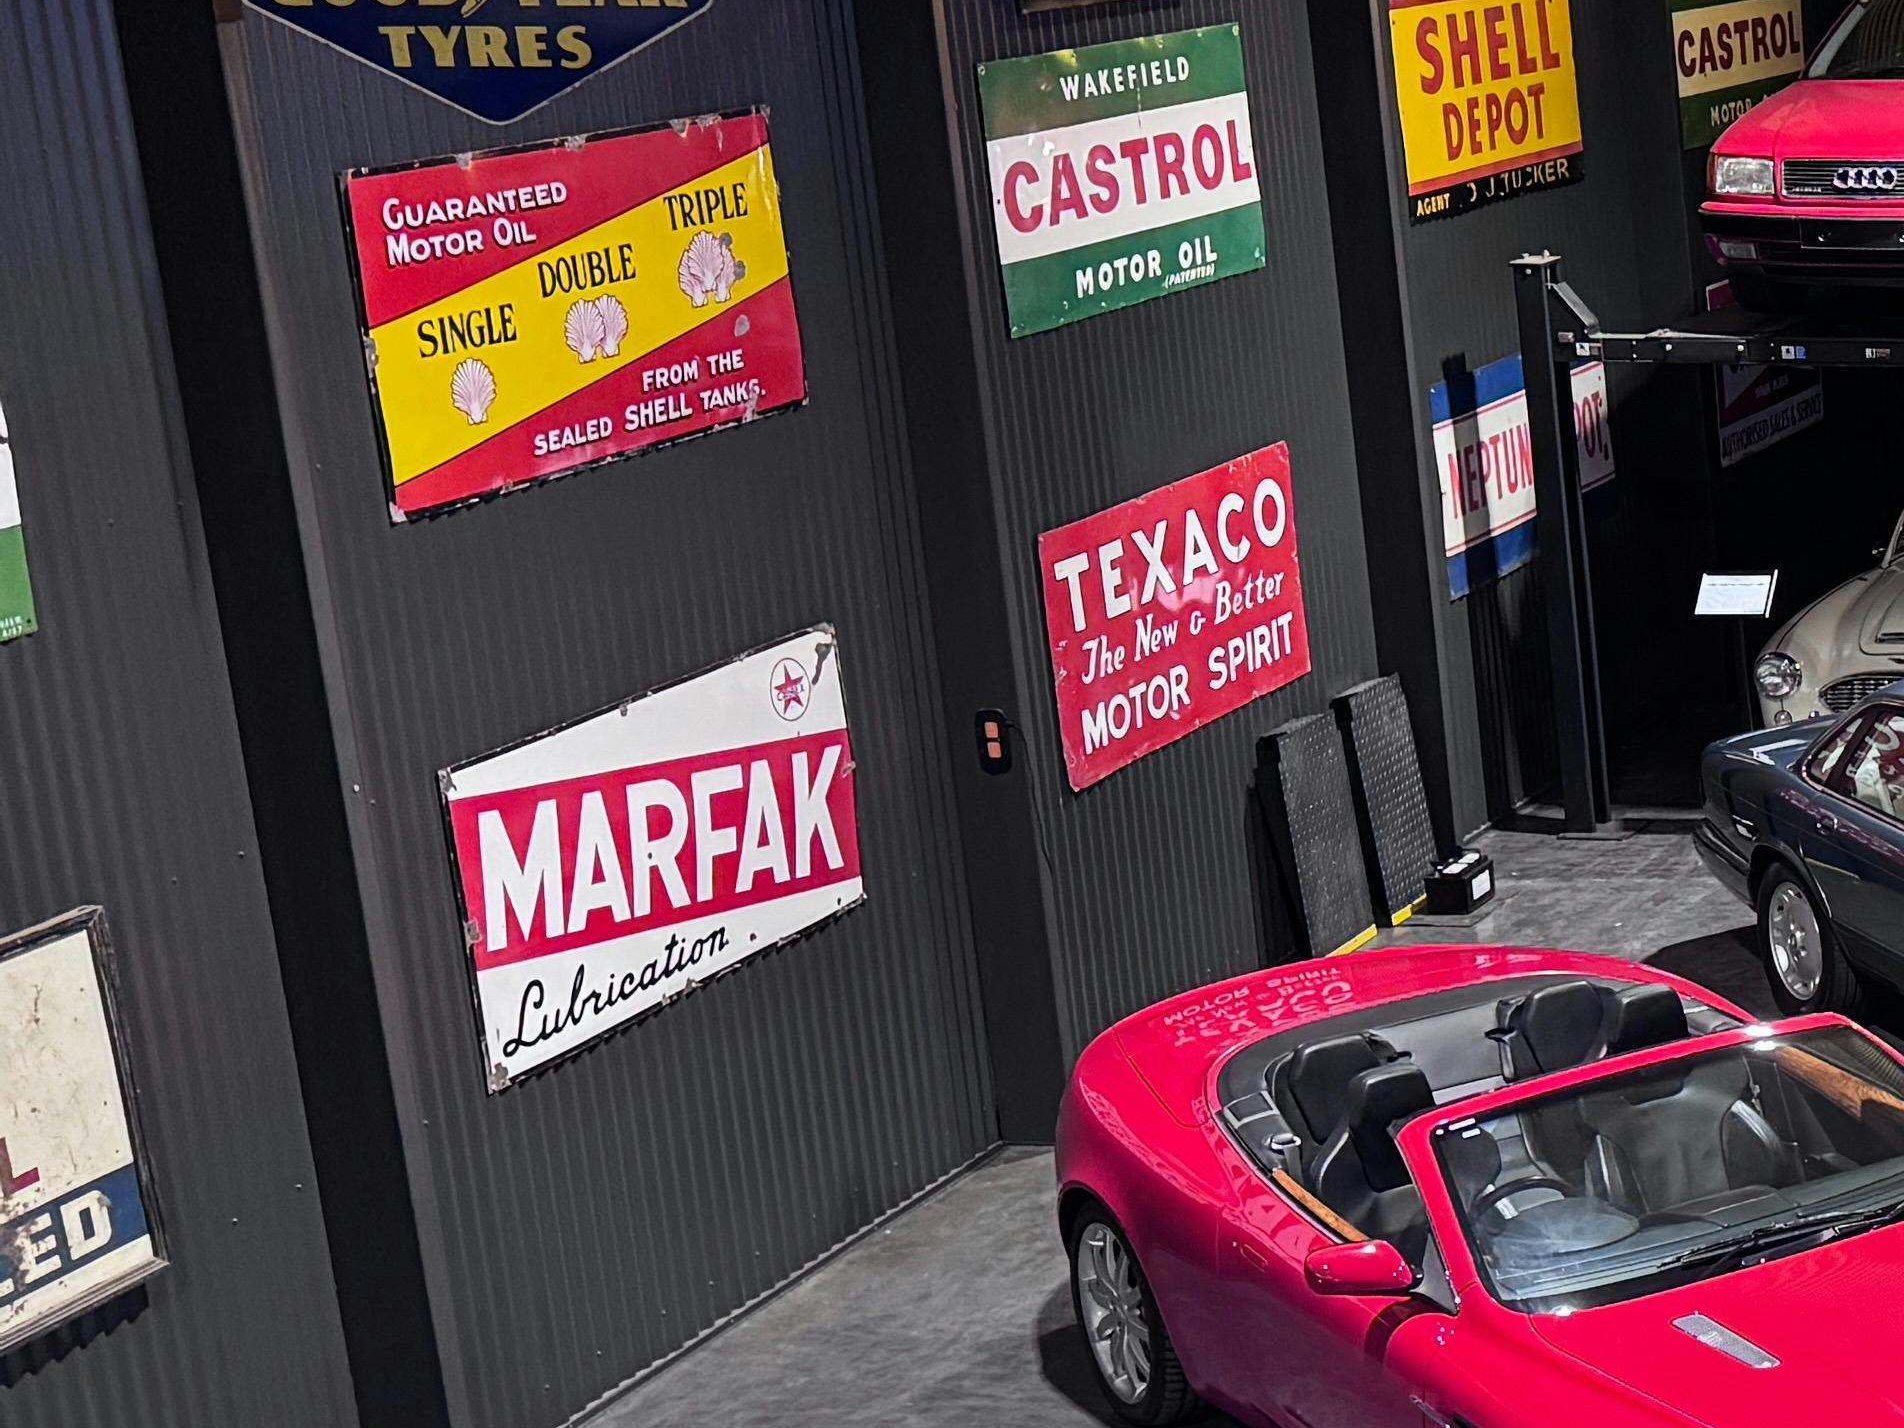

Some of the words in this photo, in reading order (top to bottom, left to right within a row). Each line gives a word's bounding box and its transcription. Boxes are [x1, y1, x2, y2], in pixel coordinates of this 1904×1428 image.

[378, 24, 592, 70] TYRES
[1677, 10, 1801, 78] CASTROL
[1060, 55, 1190, 102] WAKEFIELD
[1441, 82, 1546, 162] DEPOT
[381, 180, 568, 232] GUARANTEED
[1002, 119, 1252, 234] CASTROL
[1416, 192, 1451, 217] AGENT
[386, 228, 484, 269] MOTOR
[493, 215, 538, 247] OIL
[416, 303, 519, 360] SINGLE
[537, 243, 639, 299] DOUBLE
[663, 182, 750, 233] TRIPLE
[1075, 248, 1163, 299] MOTOR
[1178, 234, 1218, 269] OIL
[641, 358, 701, 393] FROM
[706, 348, 745, 375] THE
[533, 417, 613, 457] SEALED
[624, 392, 694, 433] SHELL
[1053, 477, 1287, 634] TEXACO
[1080, 634, 1125, 685] The
[1133, 612, 1180, 664] New
[1213, 570, 1286, 627] Better
[1080, 663, 1191, 756] MOTOR
[1207, 611, 1295, 691] SPIRIT
[476, 744, 845, 954] MARFAK
[502, 925, 731, 1059] Lubrication
